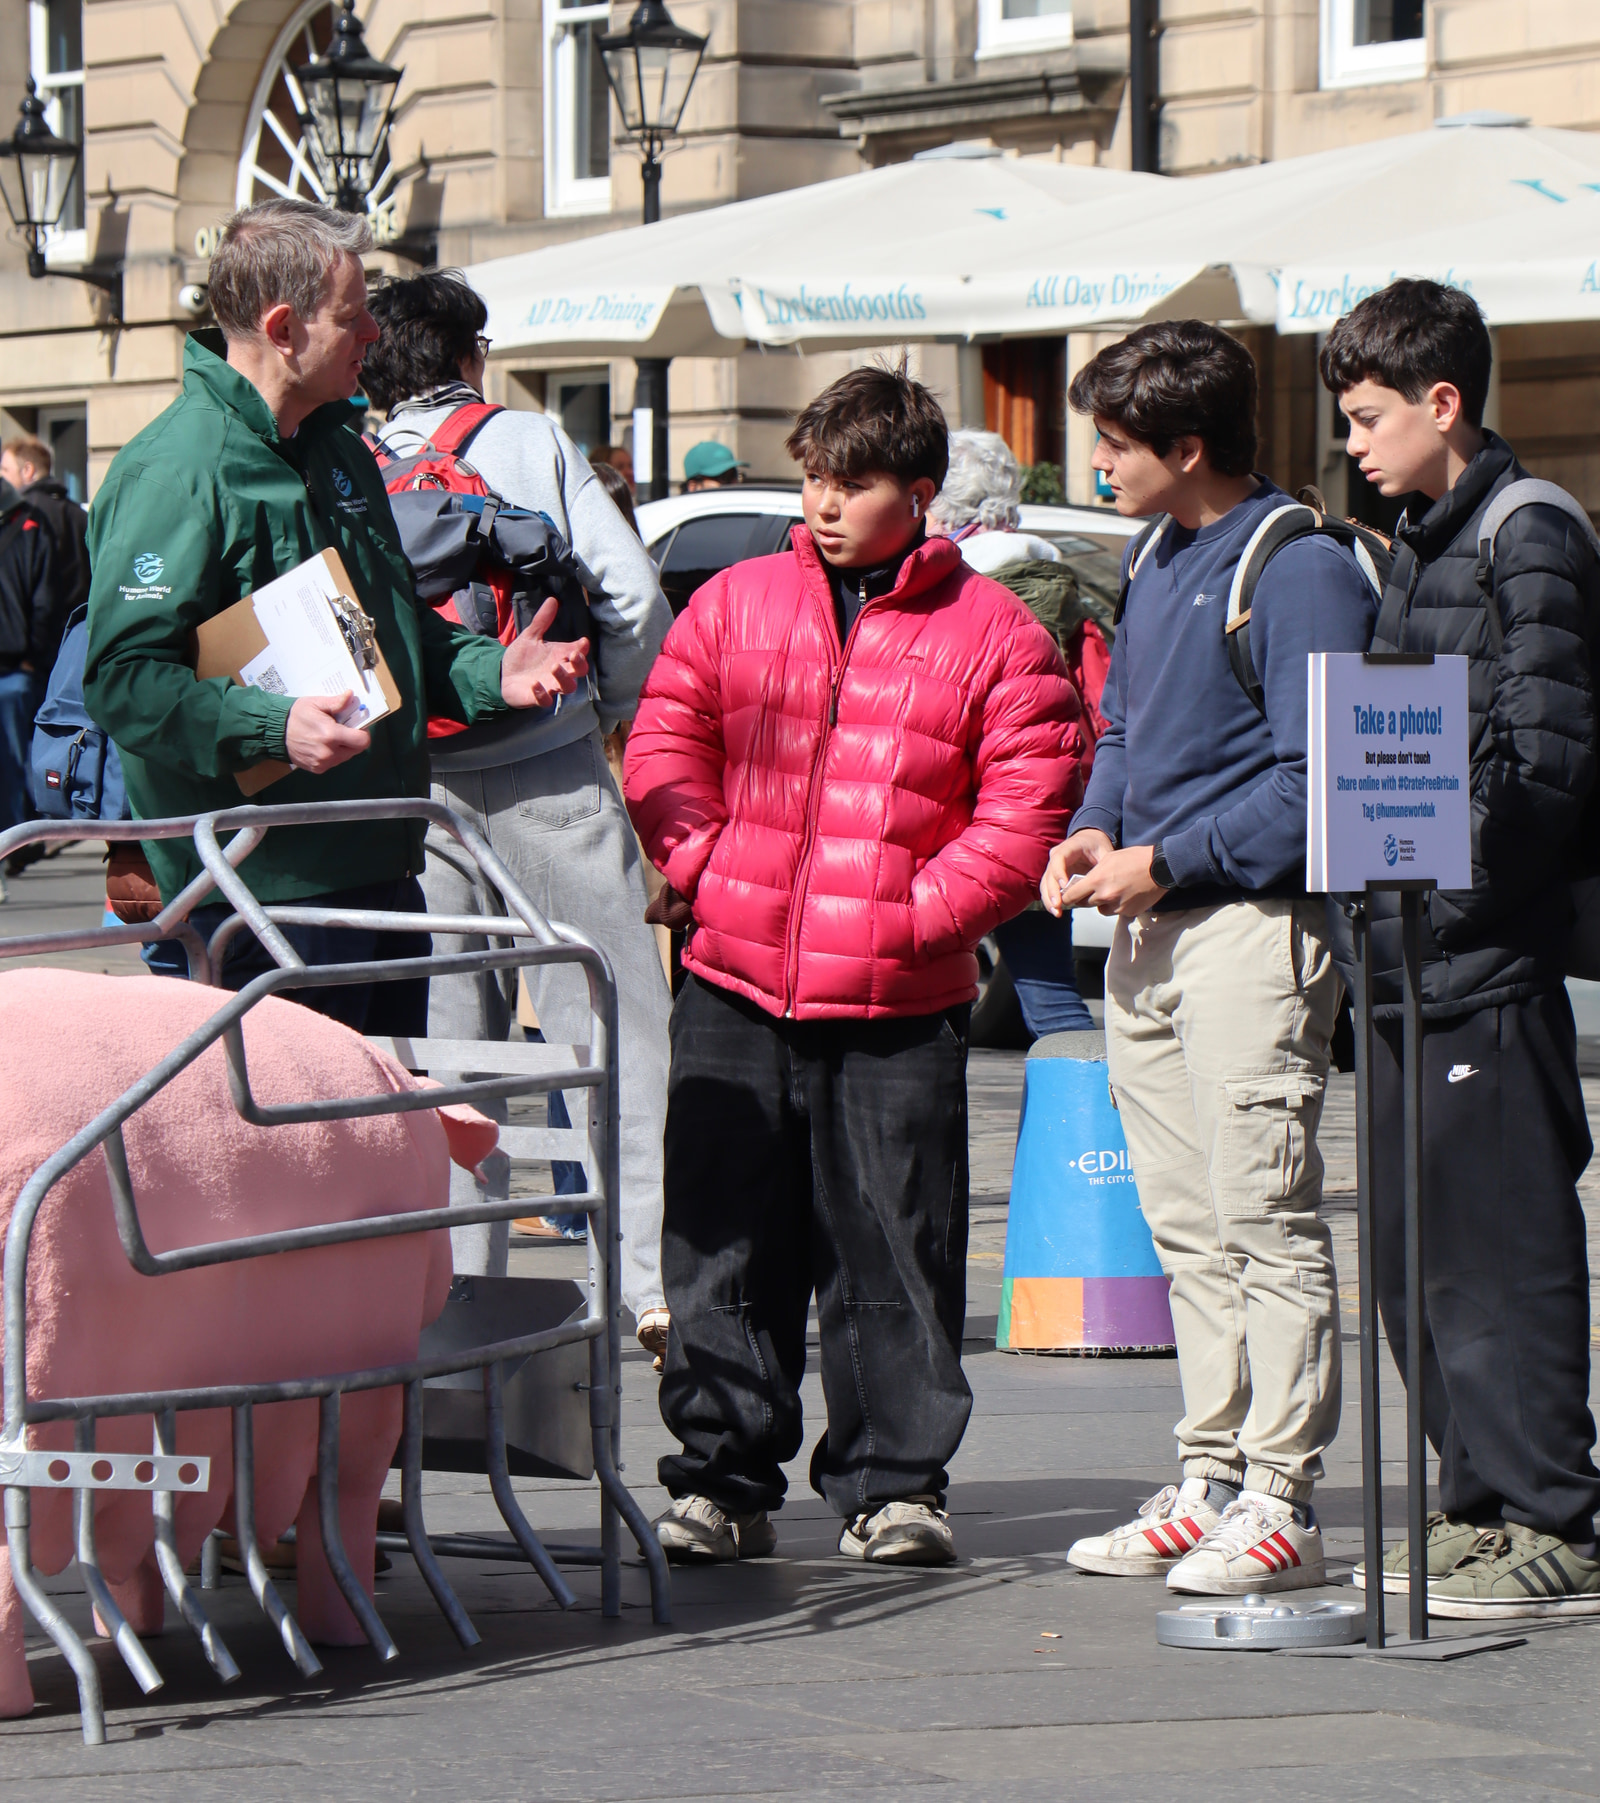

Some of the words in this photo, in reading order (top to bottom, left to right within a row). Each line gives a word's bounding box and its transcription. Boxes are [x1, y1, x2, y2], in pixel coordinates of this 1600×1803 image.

[757, 282, 927, 325] Luckenbooths
[1026, 274, 1060, 308] All
[1063, 274, 1105, 314] Day
[522, 298, 552, 327] All
[550, 298, 588, 328] Day
[587, 293, 655, 330] Dining
[124, 593, 136, 601] for
[1353, 703, 1385, 735] Take
[1387, 710, 1397, 735] a
[1399, 703, 1442, 742] photo!
[1365, 751, 1376, 765] But
[1376, 750, 1397, 767] please
[1398, 750, 1413, 765] don't
[1413, 750, 1431, 765] touch
[1336, 775, 1357, 792] Share
[1358, 775, 1380, 791] online
[1380, 775, 1397, 791] with
[1397, 774, 1460, 791] #CrateFreeBritain
[1362, 802, 1375, 822] Tag
[1375, 801, 1436, 820] @humaneworlduk
[1452, 1064, 1472, 1075] NIKE
[1088, 1176, 1105, 1186] THE
[1106, 1175, 1126, 1185] CITY
[1127, 1174, 1135, 1183] O
